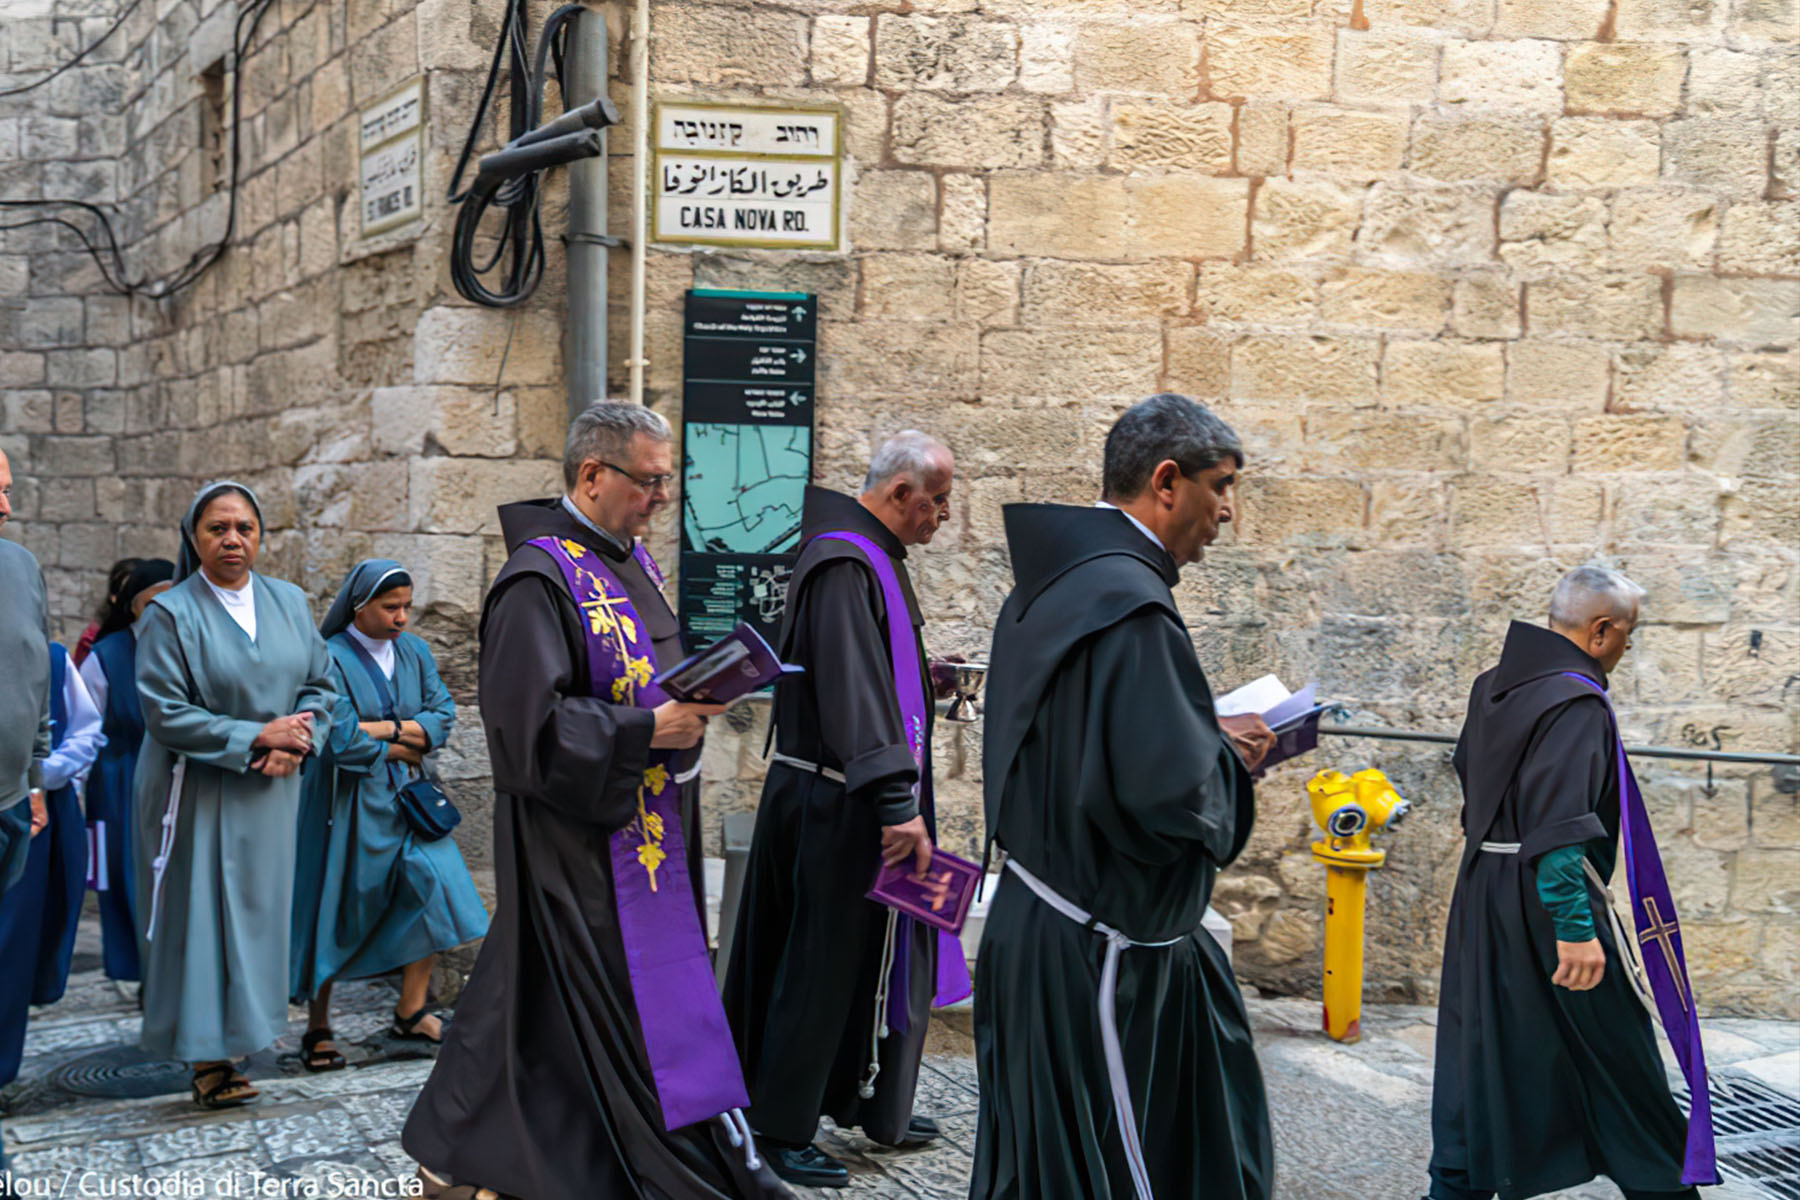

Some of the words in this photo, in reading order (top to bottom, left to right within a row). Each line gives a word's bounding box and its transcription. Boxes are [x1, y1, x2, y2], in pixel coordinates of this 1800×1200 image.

[776, 125, 819, 148] רחוב
[771, 170, 828, 197] طريق
[680, 206, 726, 229] CASA
[734, 208, 778, 231] NOVA
